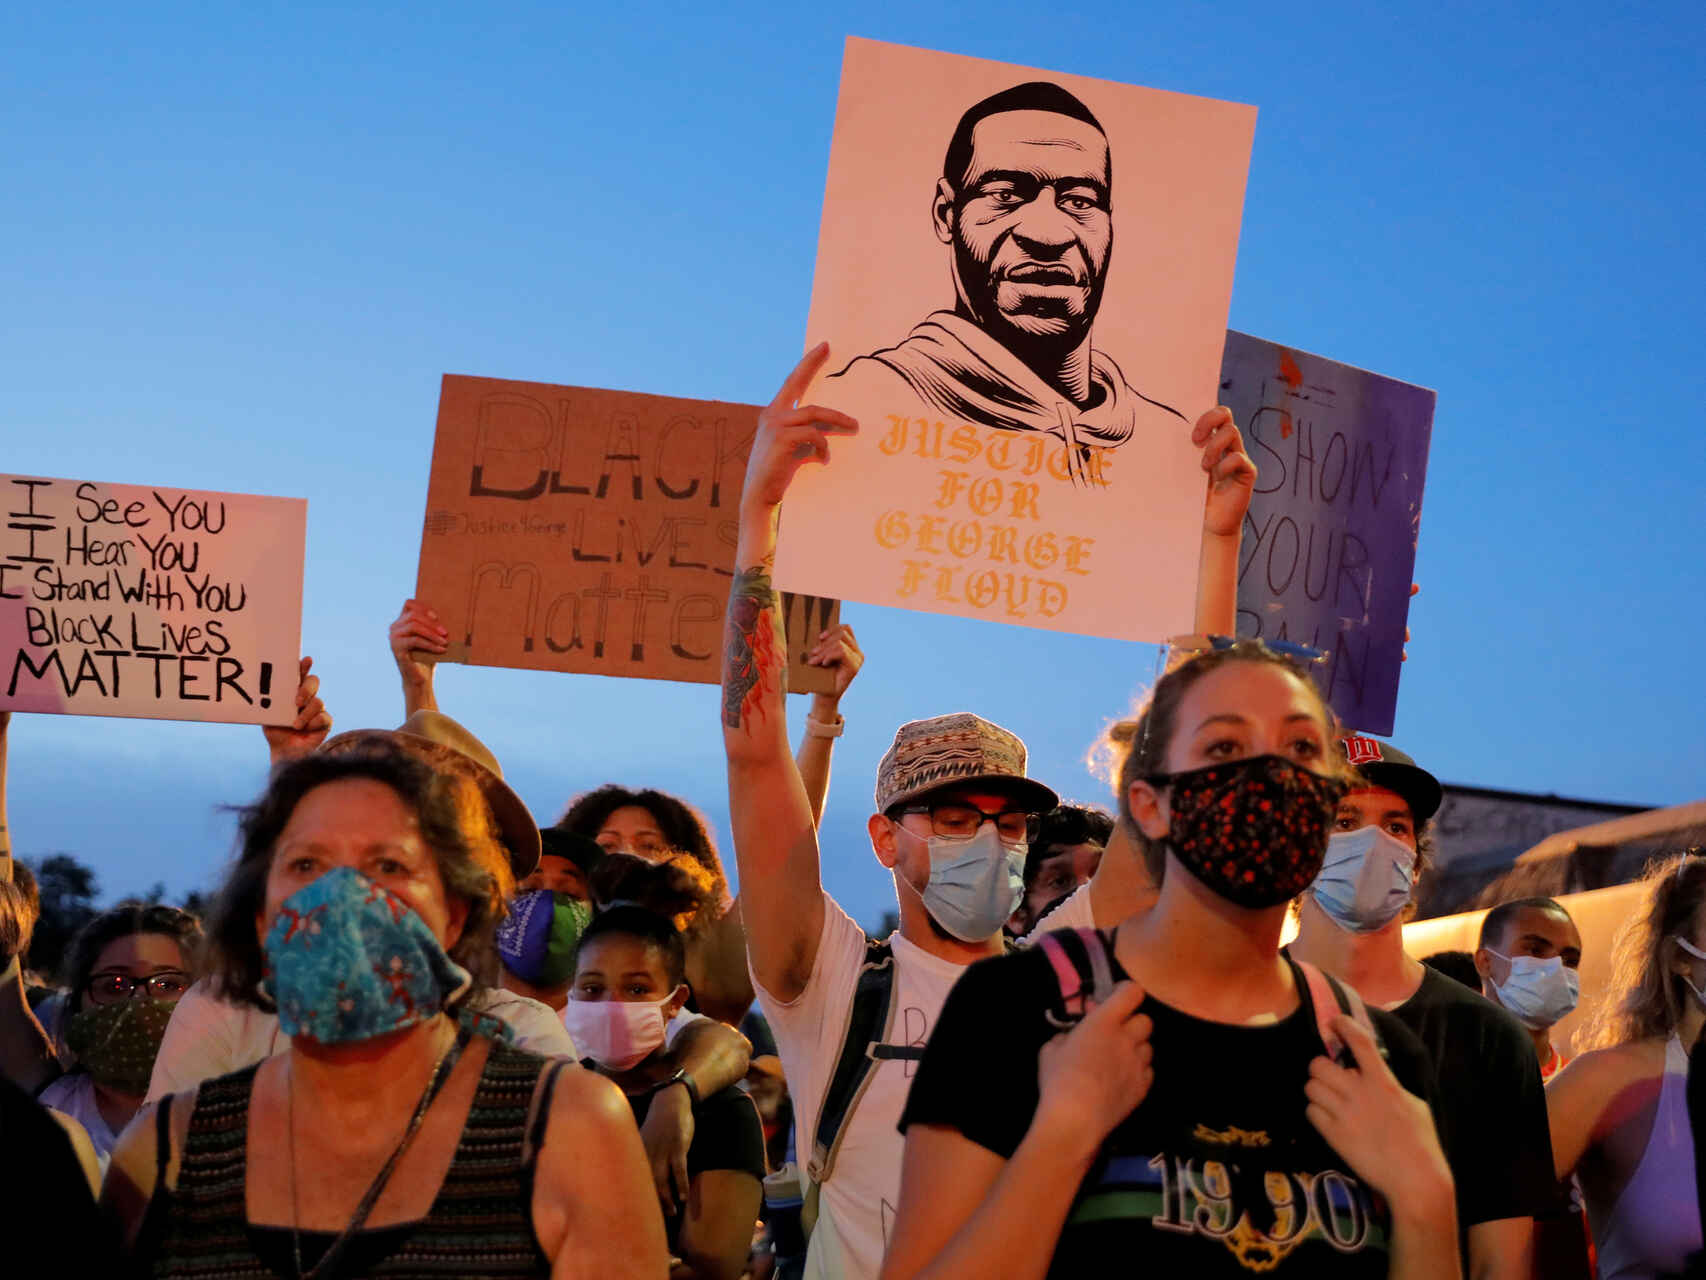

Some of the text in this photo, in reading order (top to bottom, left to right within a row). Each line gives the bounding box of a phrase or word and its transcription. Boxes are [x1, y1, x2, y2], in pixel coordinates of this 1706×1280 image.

[878, 414, 1117, 486] JUSTICE
[1249, 406, 1396, 506] SHOW
[9, 480, 55, 519] I
[76, 483, 150, 527] See
[934, 469, 1040, 521] FOR
[7, 523, 56, 563] I
[66, 525, 136, 566] Hear
[874, 508, 1096, 576] GEORGE
[1238, 510, 1369, 616] YOUR
[32, 566, 110, 602] Stand
[114, 568, 184, 611] With
[464, 560, 722, 662] Matte
[896, 559, 1068, 618] FLOYD
[132, 612, 231, 656] Lives
[7, 648, 273, 709] MATTER!
[1148, 1152, 1370, 1252] 1990
